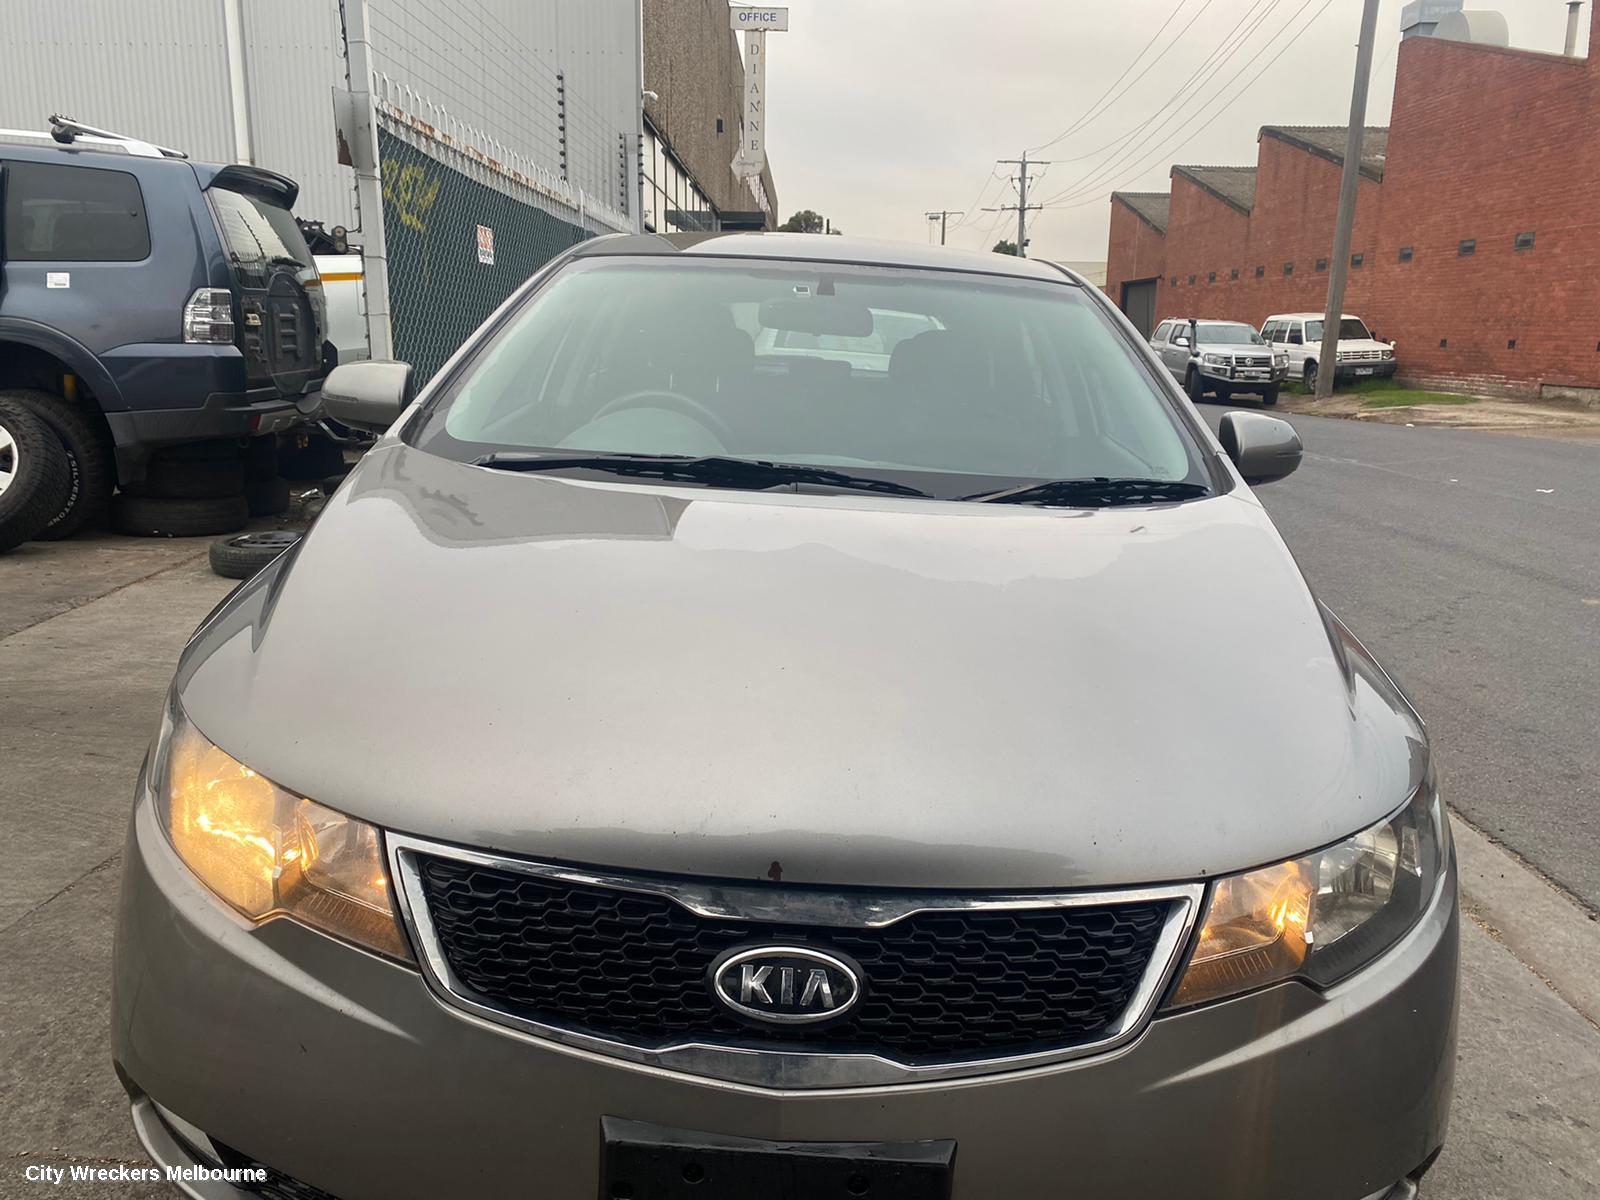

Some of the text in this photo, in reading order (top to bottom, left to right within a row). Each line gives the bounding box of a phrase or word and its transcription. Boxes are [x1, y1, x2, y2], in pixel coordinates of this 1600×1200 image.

[739, 12, 777, 22] OFFICE
[750, 44, 760, 151] DIANNE
[740, 964, 836, 1009] KIA
